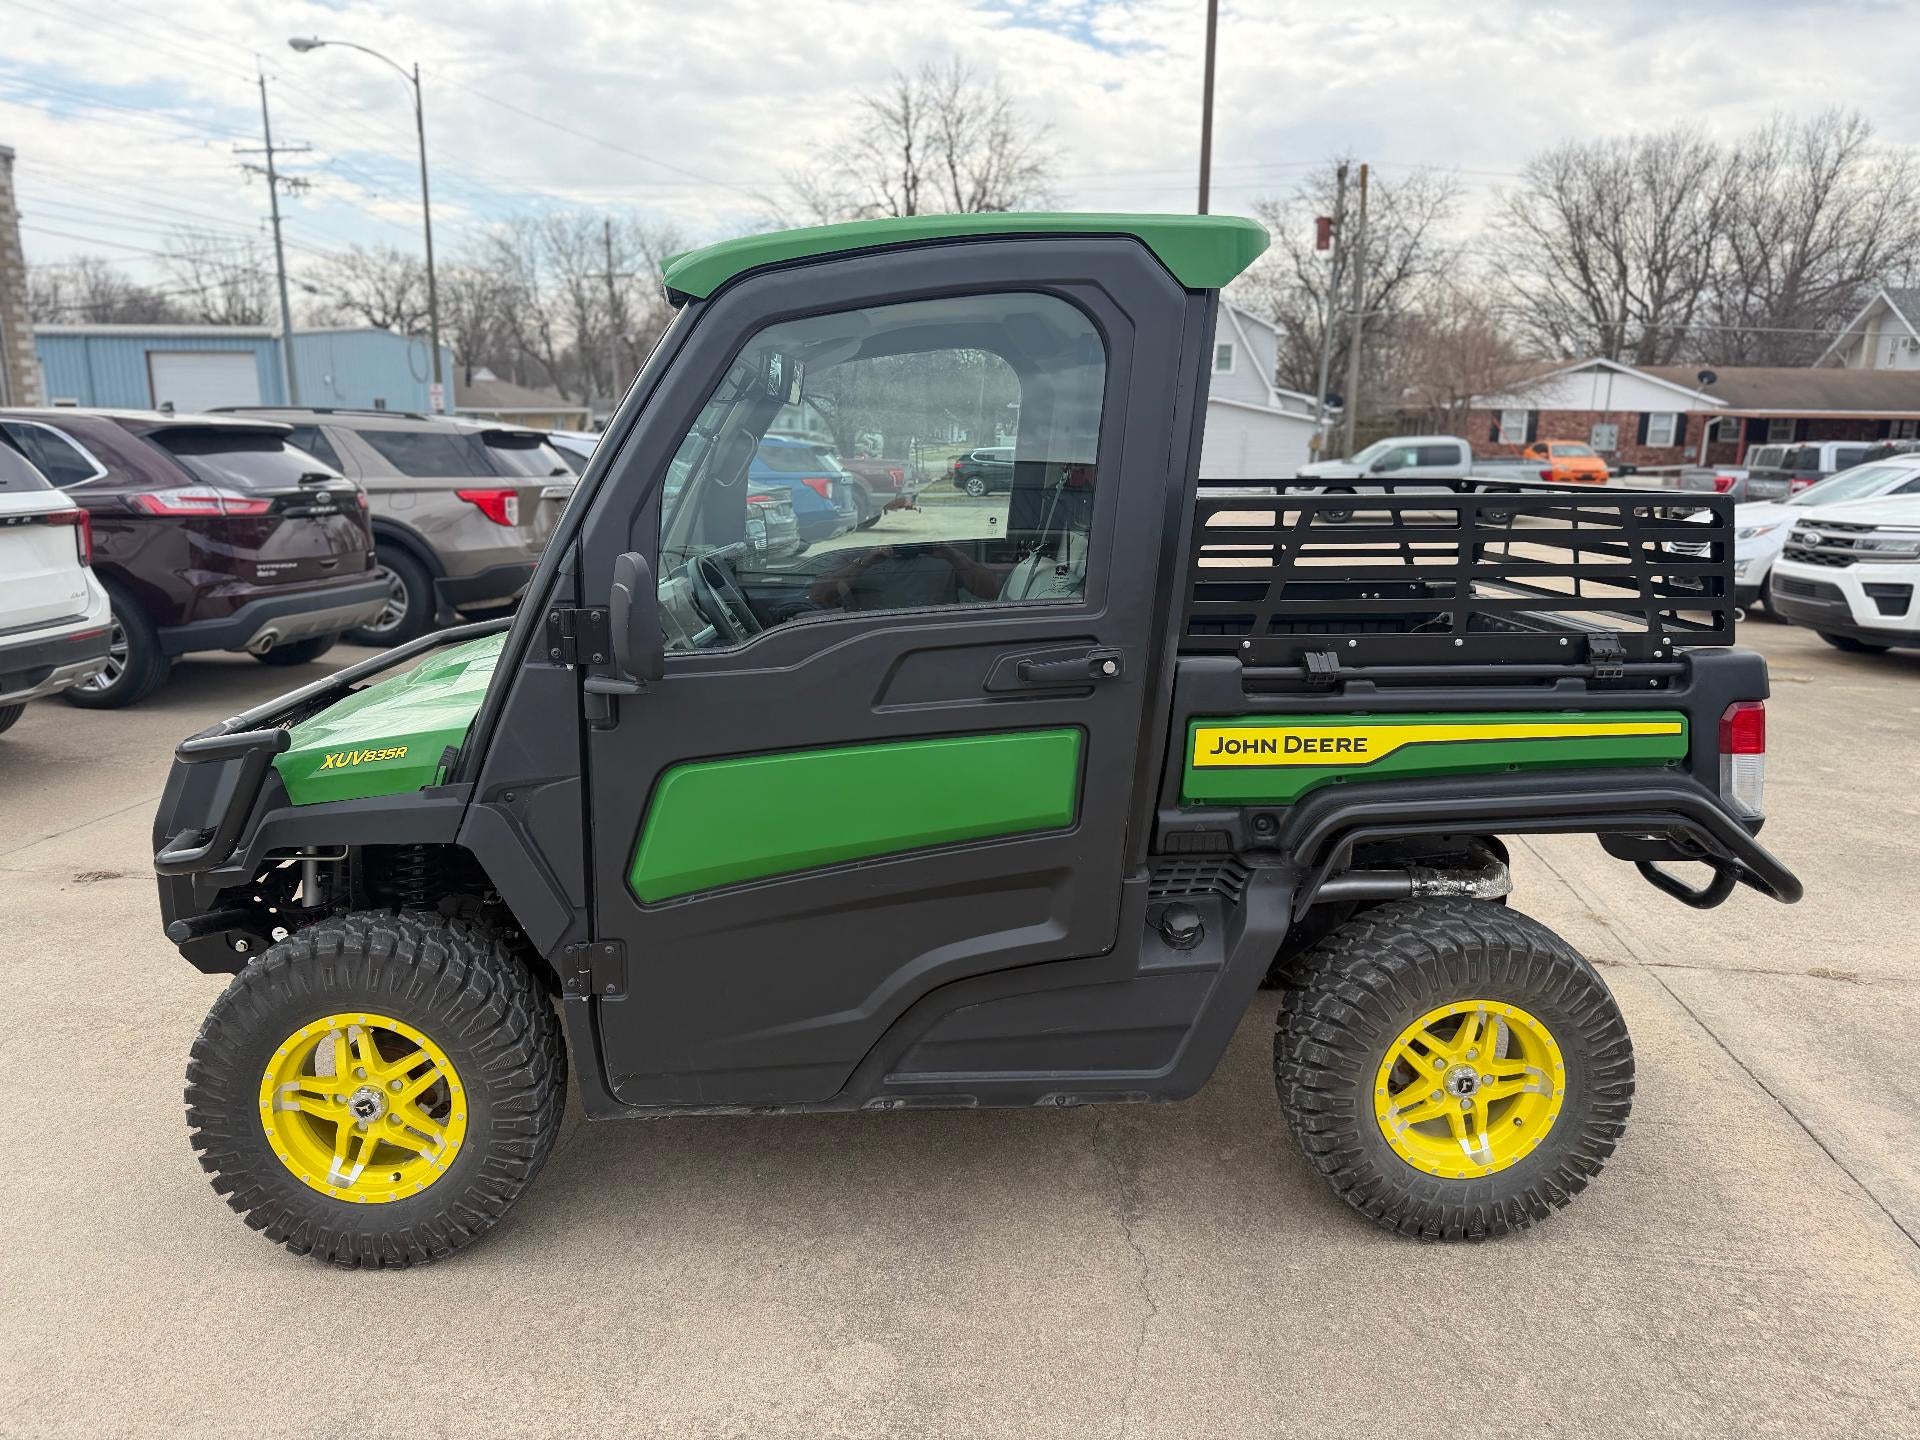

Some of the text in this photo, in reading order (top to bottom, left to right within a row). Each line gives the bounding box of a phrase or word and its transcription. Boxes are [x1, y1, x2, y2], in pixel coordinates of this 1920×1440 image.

[1210, 735, 1368, 755] JOHN DEERE
[319, 746, 408, 770] XUV835R
